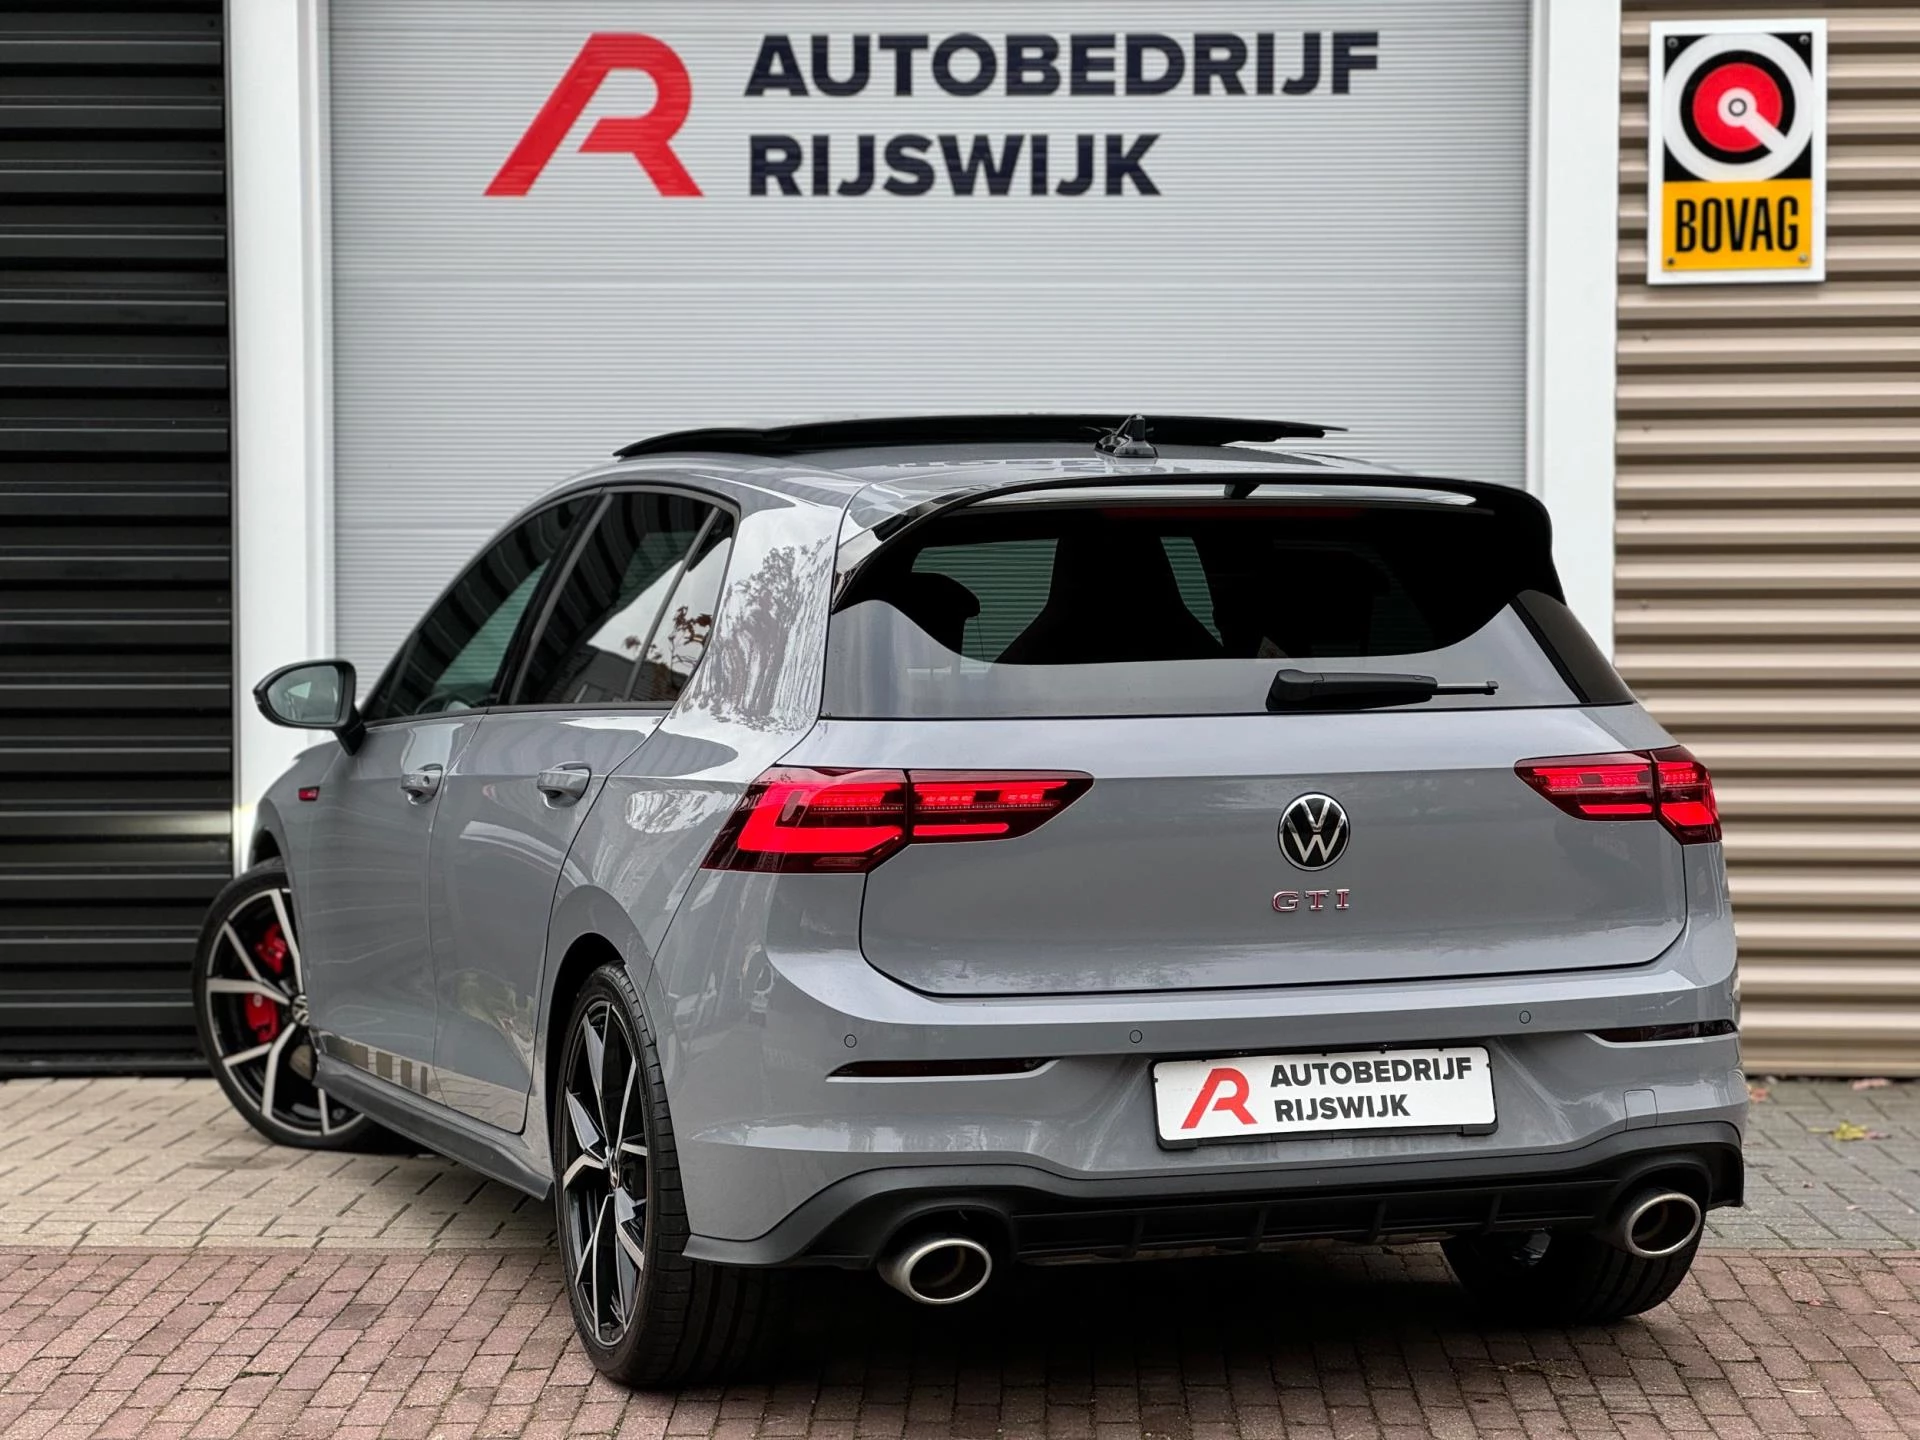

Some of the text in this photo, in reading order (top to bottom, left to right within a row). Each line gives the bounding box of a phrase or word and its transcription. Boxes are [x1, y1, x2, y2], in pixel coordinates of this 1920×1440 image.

[745, 31, 1379, 97] AUTOBEDRIJF
[749, 133, 1161, 197] RIJSWIJK
[1675, 196, 1798, 253] BOVAG
[1272, 889, 1350, 912] GTI
[1270, 1057, 1472, 1088] AUTOBEDRIJF
[1274, 1094, 1411, 1122] RIJSWIJK
